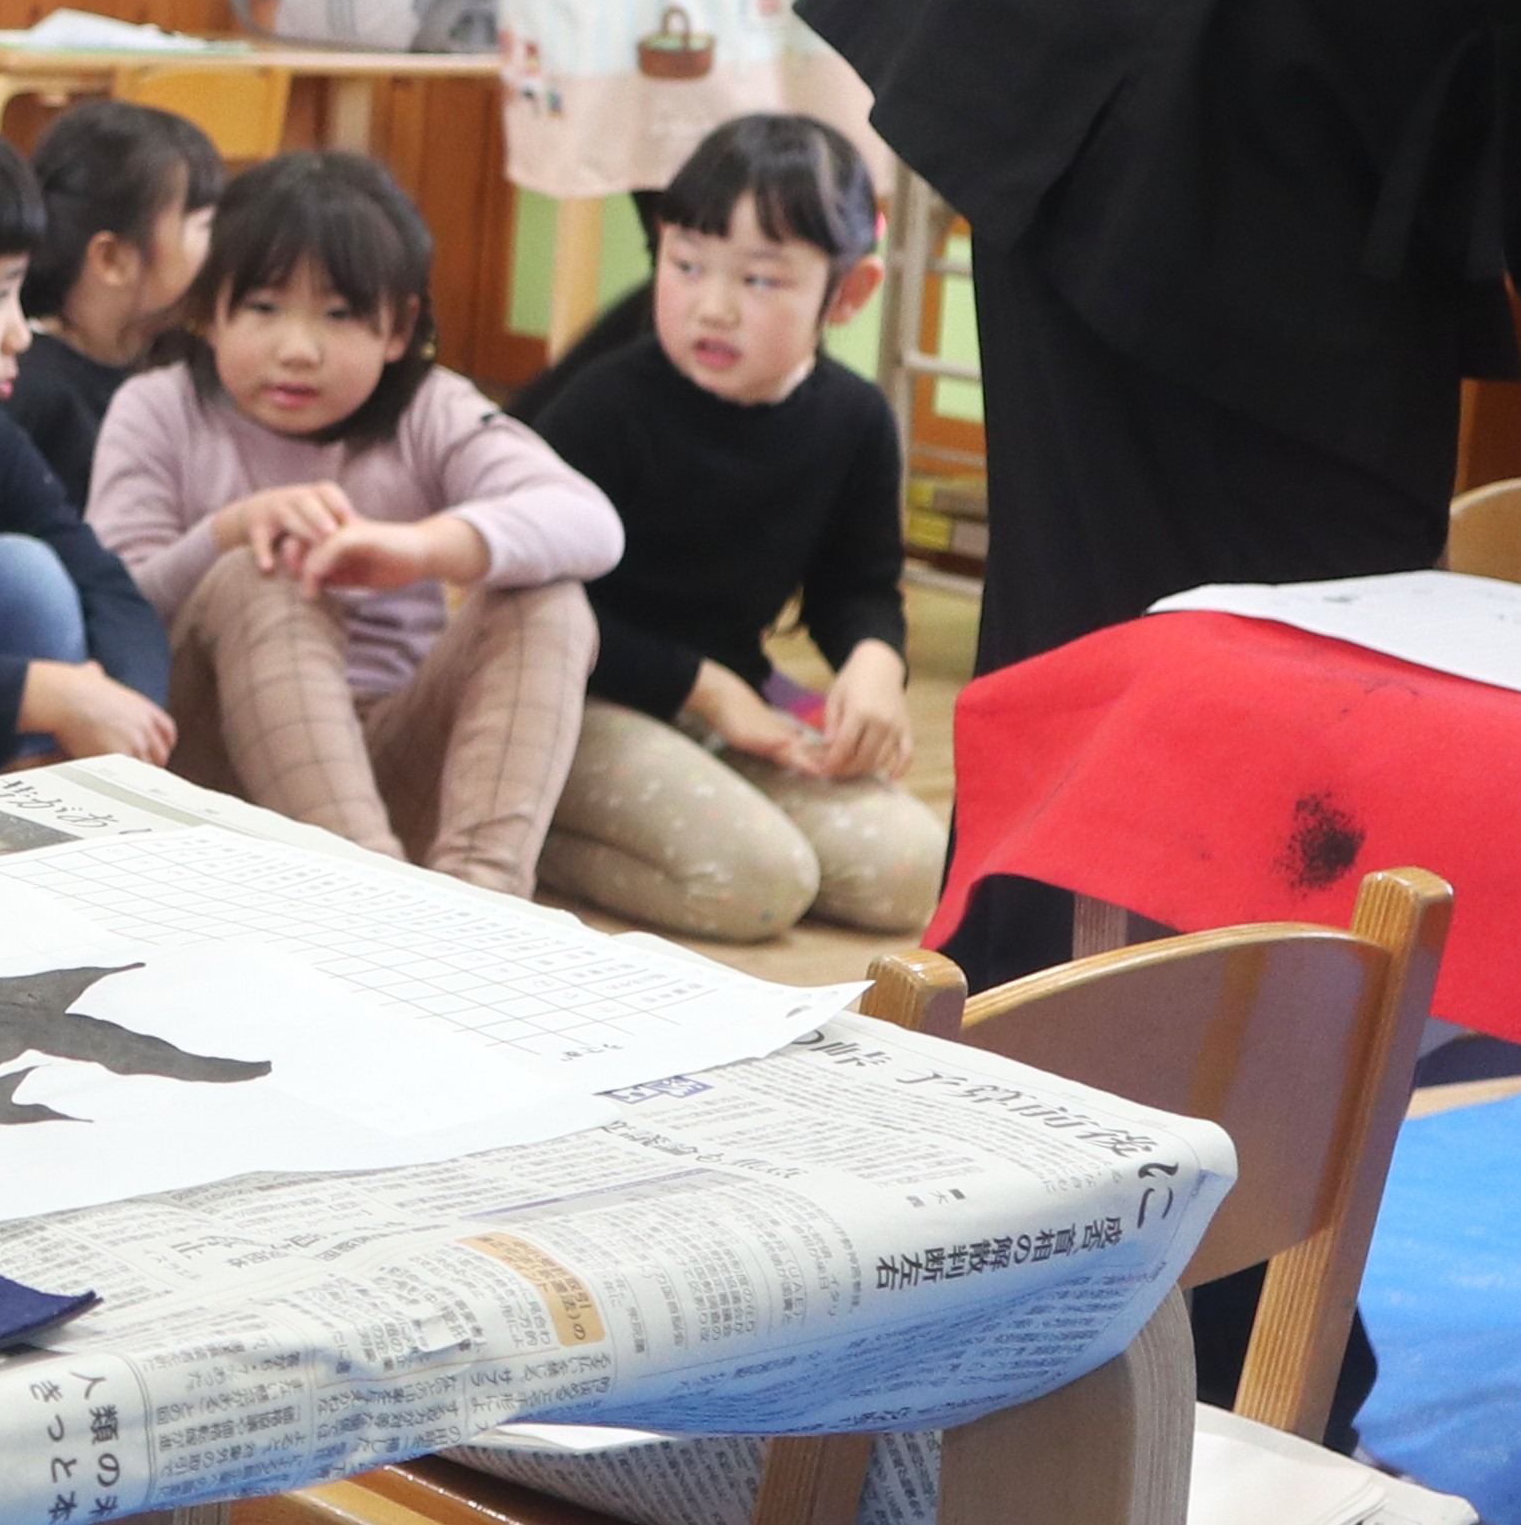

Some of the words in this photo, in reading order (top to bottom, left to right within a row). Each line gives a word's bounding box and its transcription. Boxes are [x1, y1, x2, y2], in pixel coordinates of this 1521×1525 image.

[875, 1215, 1125, 1292] 成否、首相の解散判断左右
[29, 1379, 78, 1525] きっと本
